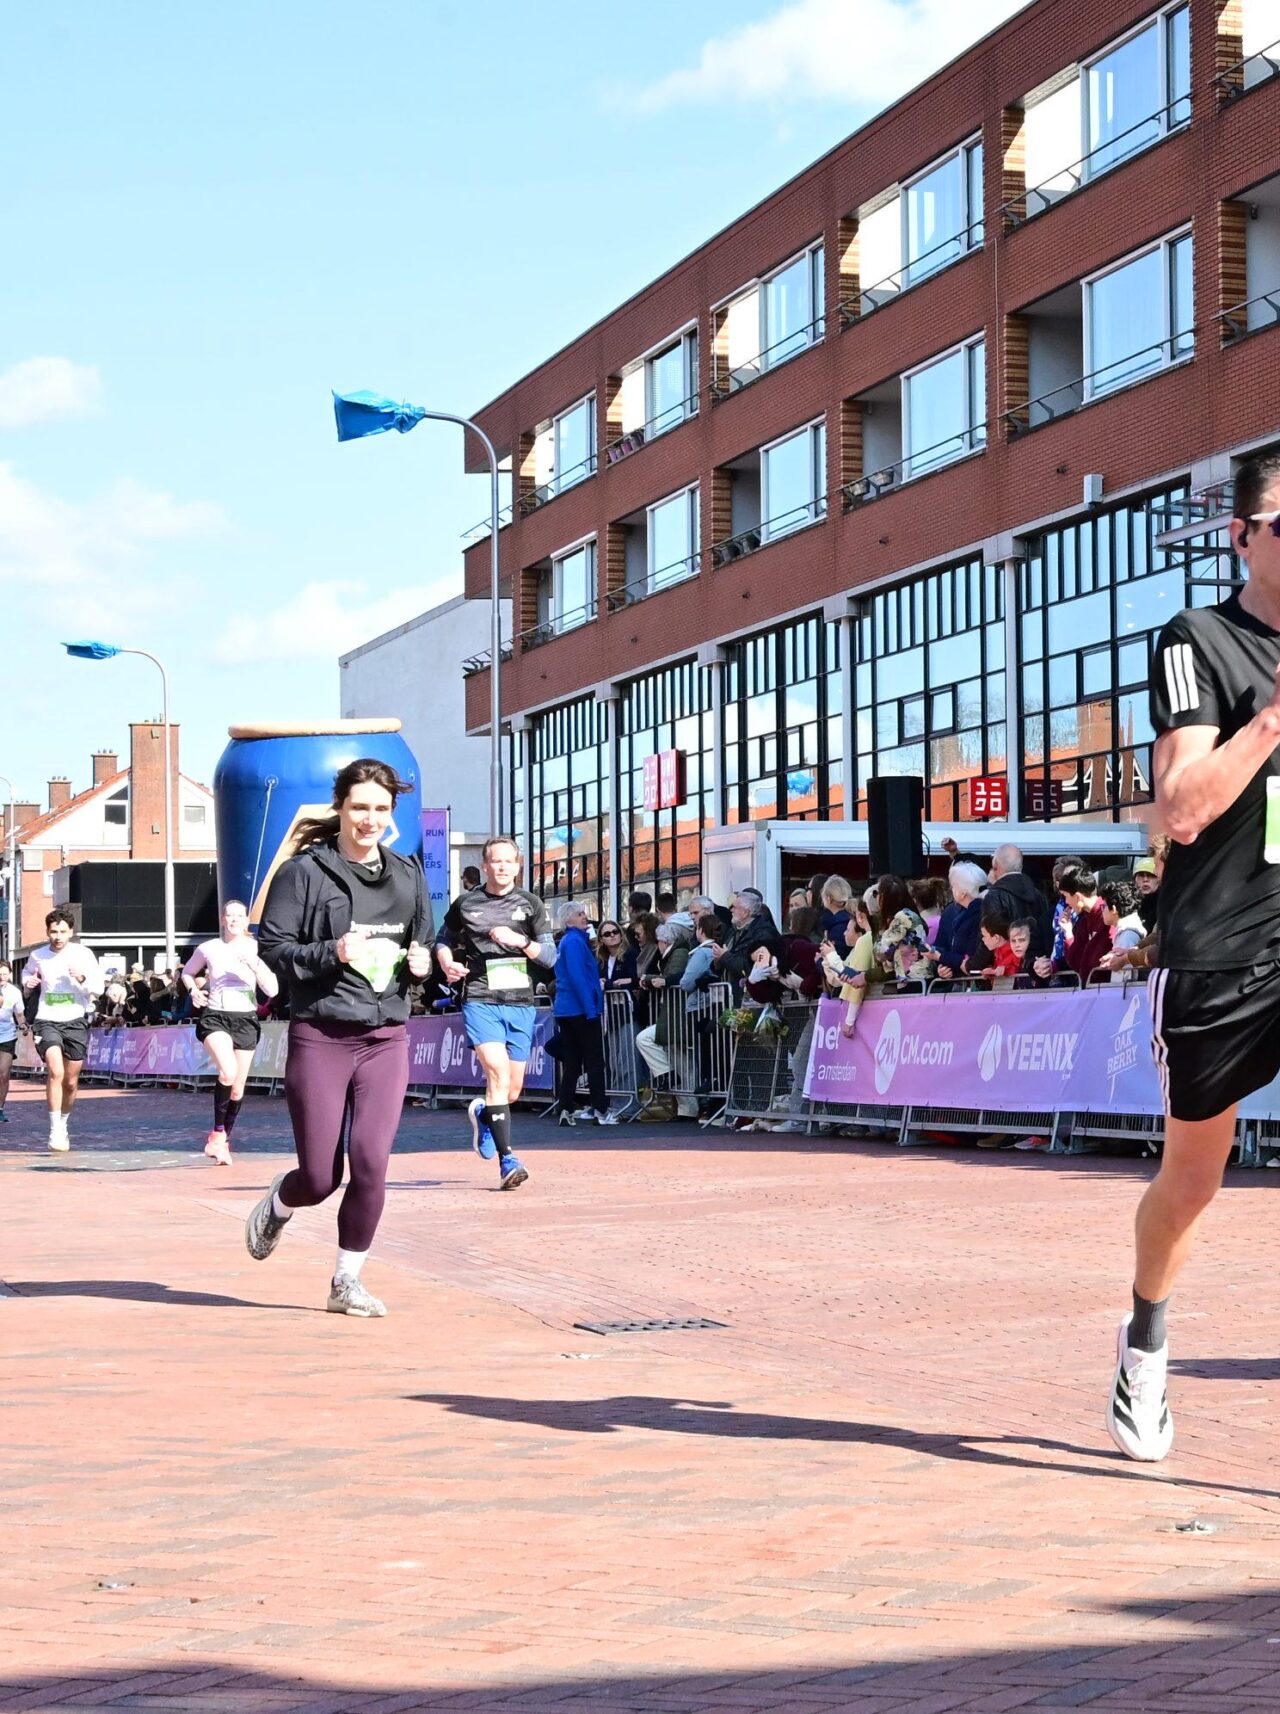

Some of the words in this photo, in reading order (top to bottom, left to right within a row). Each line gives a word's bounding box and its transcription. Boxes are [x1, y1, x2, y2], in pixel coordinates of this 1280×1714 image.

[425, 829, 445, 837] RUN
[451, 1034, 465, 1066] LG
[900, 1034, 954, 1065] CM.com
[1007, 1033, 1078, 1071] VEENIX
[1114, 1029, 1133, 1053] OAK
[817, 1062, 857, 1081] amsterdam
[1107, 1045, 1138, 1075] BERRY
